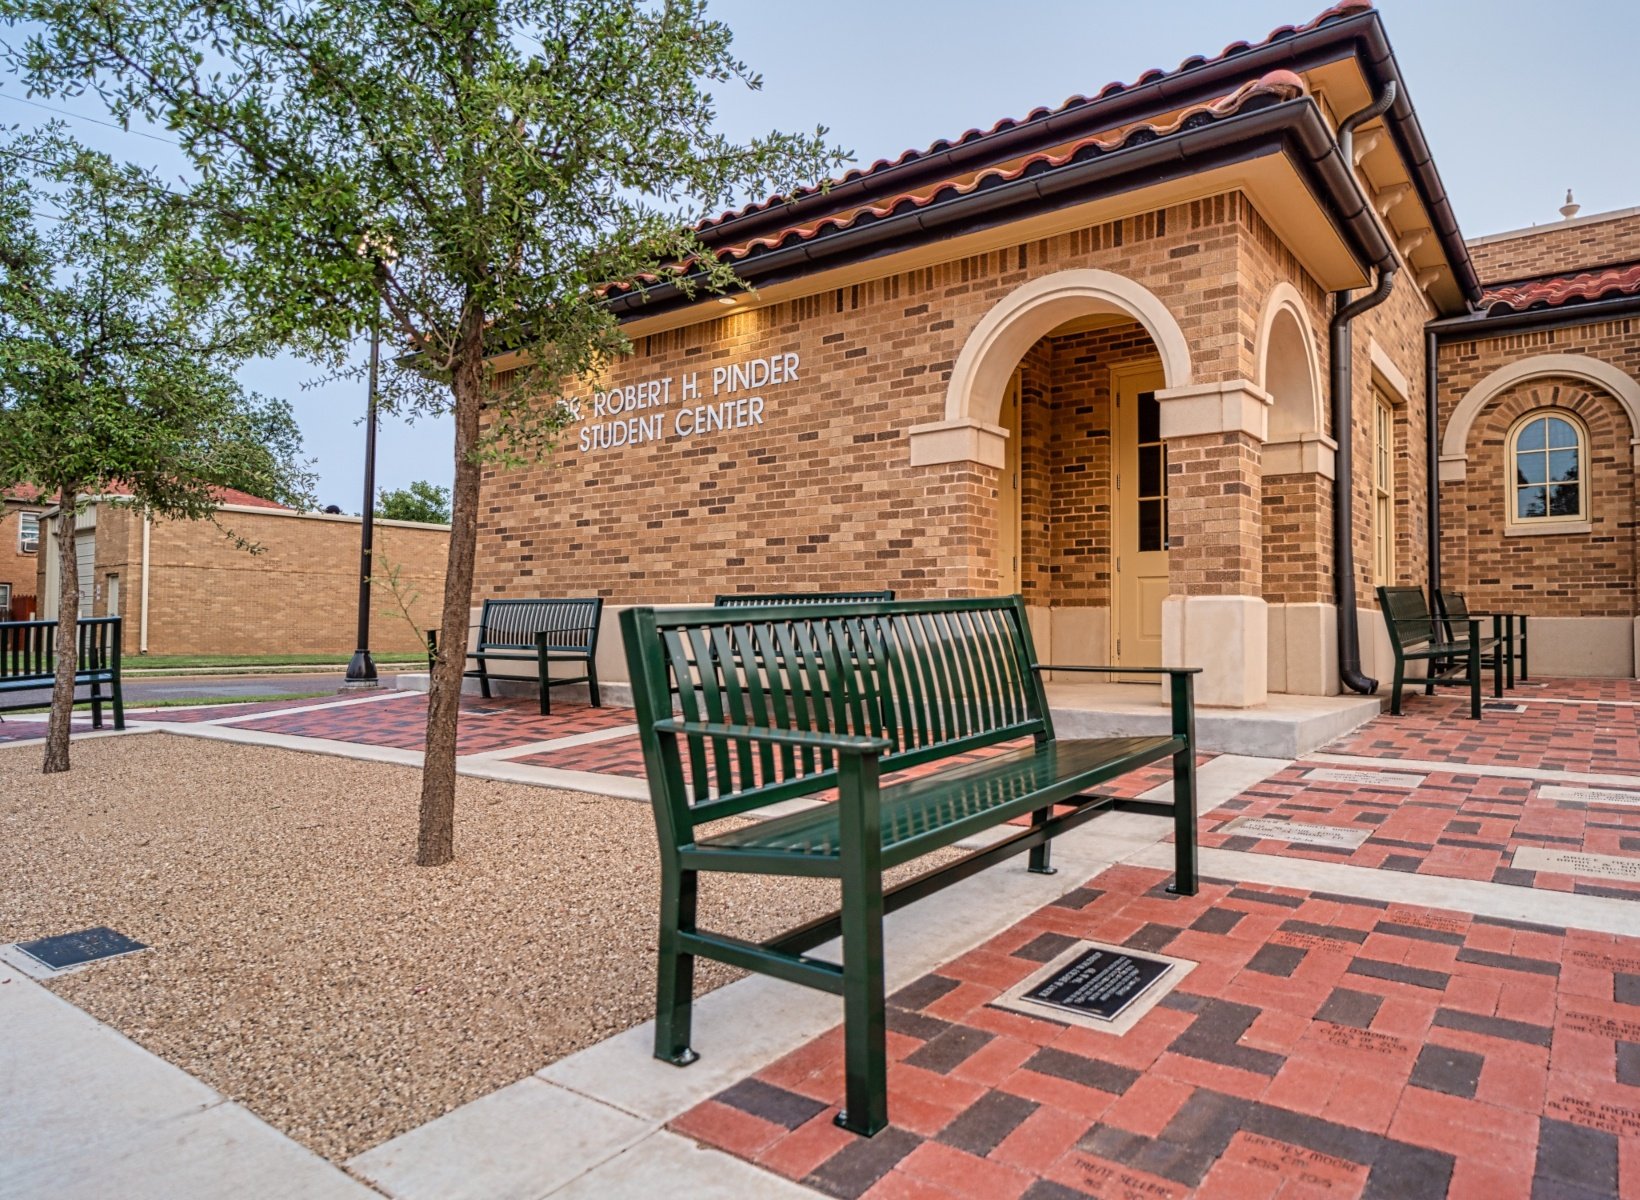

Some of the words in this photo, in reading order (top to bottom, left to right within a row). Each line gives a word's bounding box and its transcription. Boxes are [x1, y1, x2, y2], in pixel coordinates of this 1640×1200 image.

[594, 377, 673, 418] ROBERT
[682, 371, 702, 401] H.
[713, 352, 800, 396] PINDER
[579, 413, 666, 452] STUDENT
[675, 396, 765, 437] CENTER
[1309, 1150, 1359, 1173] MOORE
